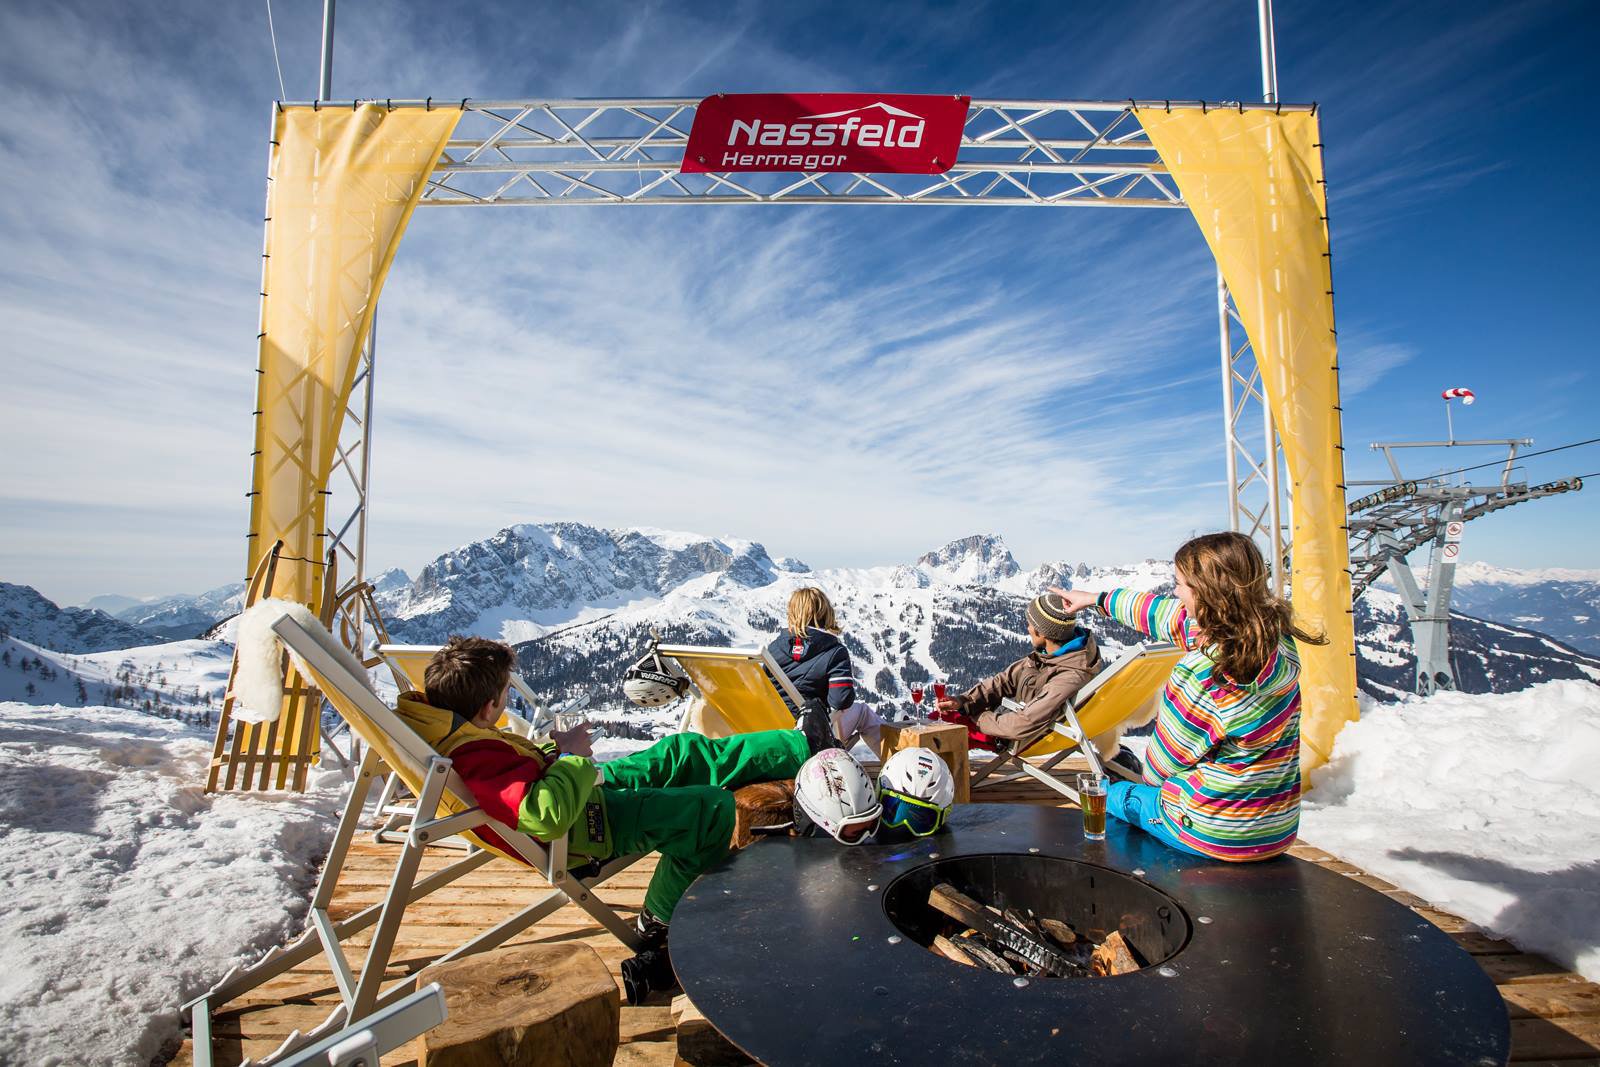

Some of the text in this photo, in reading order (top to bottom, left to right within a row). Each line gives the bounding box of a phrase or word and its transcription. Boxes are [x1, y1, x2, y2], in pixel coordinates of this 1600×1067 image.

[727, 117, 926, 148] Nassfeld
[721, 152, 847, 169] Hermagor
[640, 671, 679, 687] CARRERA
